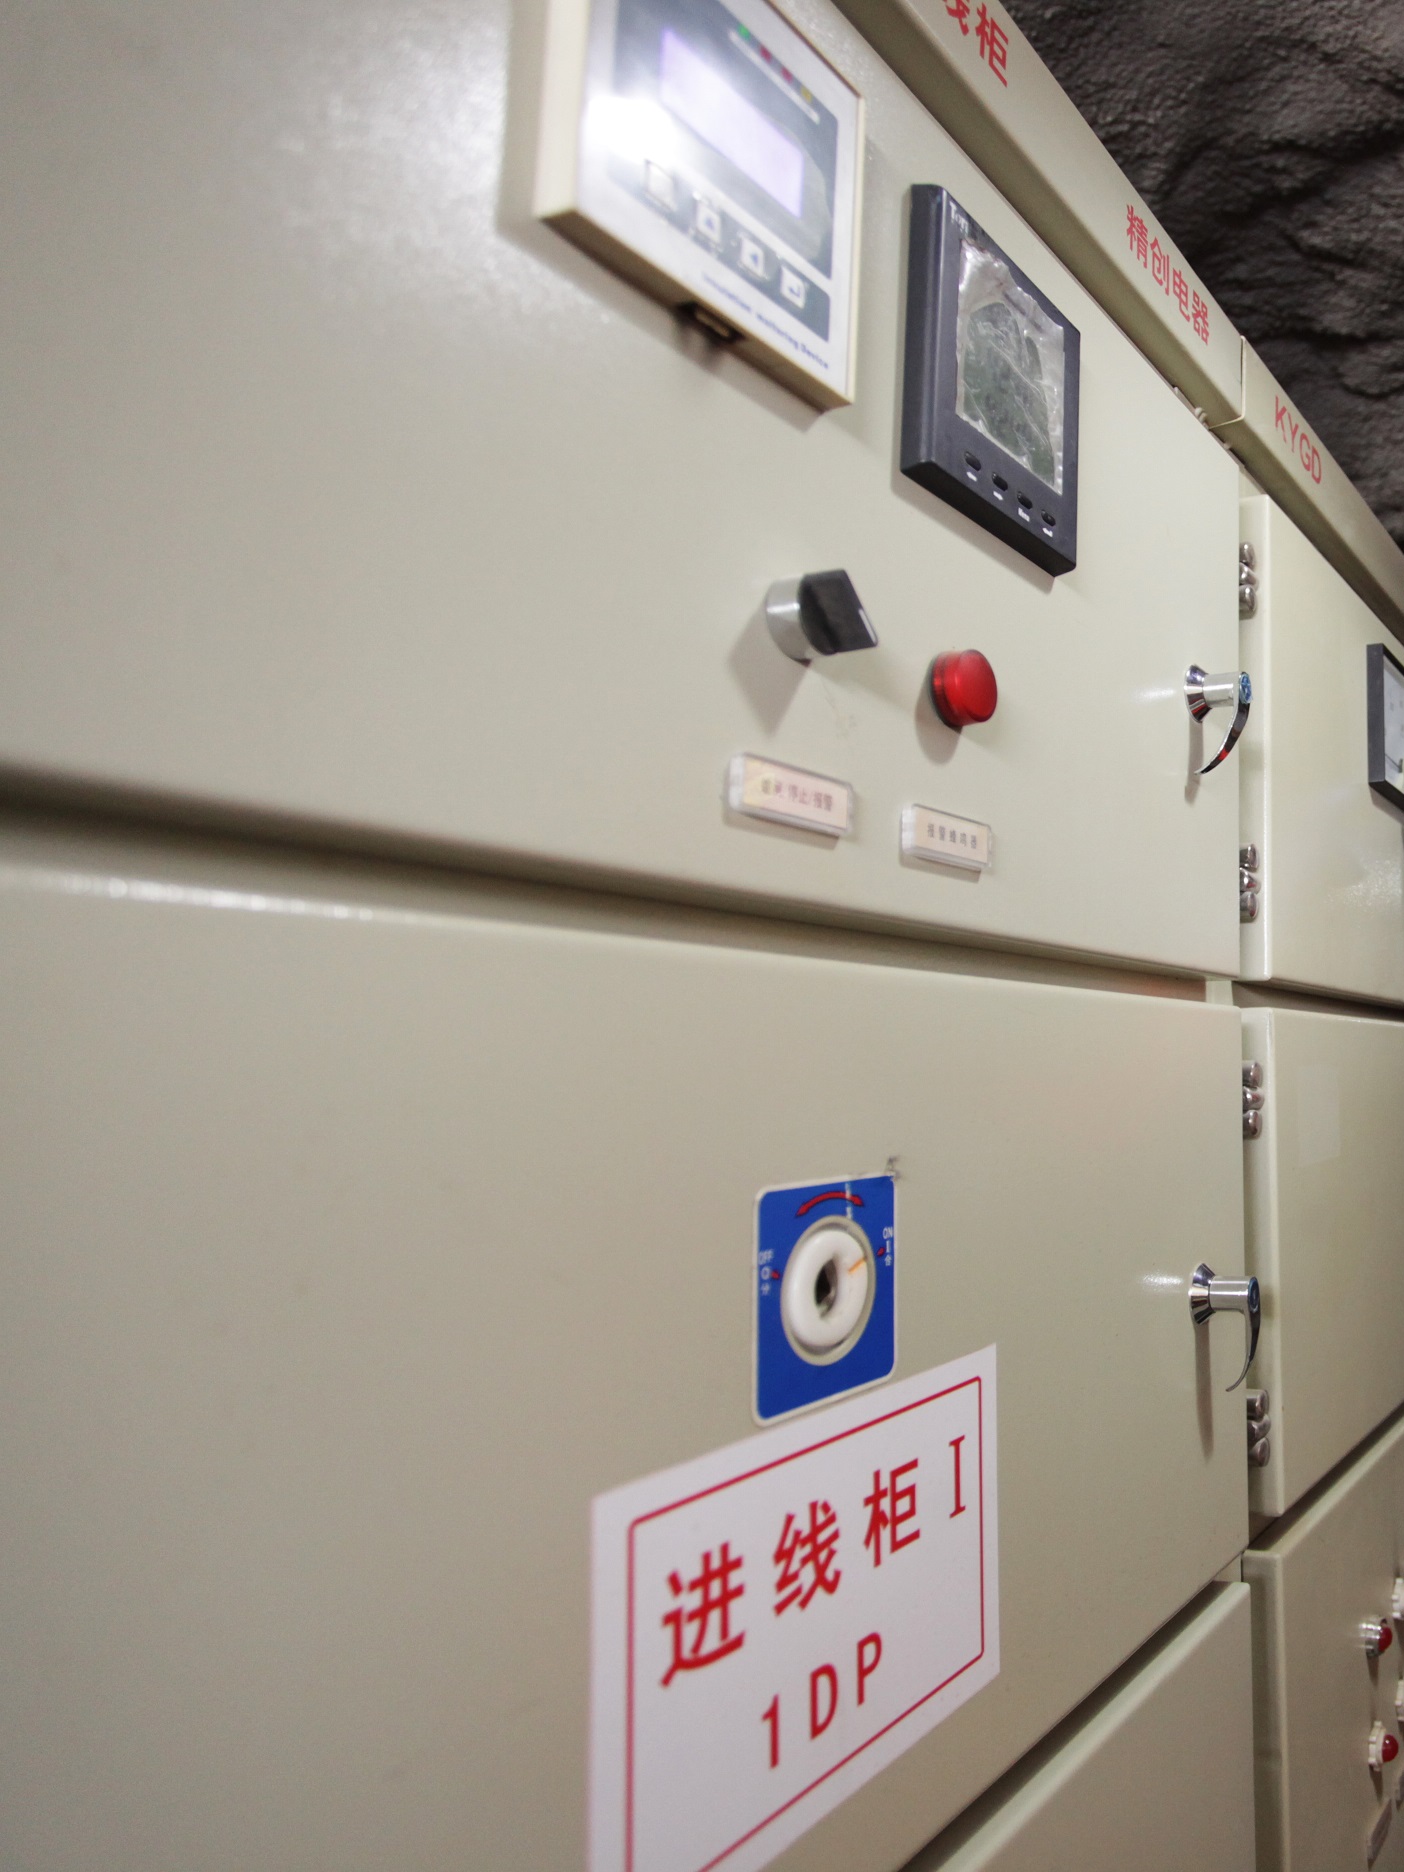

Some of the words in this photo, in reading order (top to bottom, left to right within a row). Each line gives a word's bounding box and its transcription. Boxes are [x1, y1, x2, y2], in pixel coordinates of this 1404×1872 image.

[1126, 204, 1210, 346] 精创电器
[1275, 394, 1323, 485] KYGD
[761, 1631, 883, 1770] 1DP
